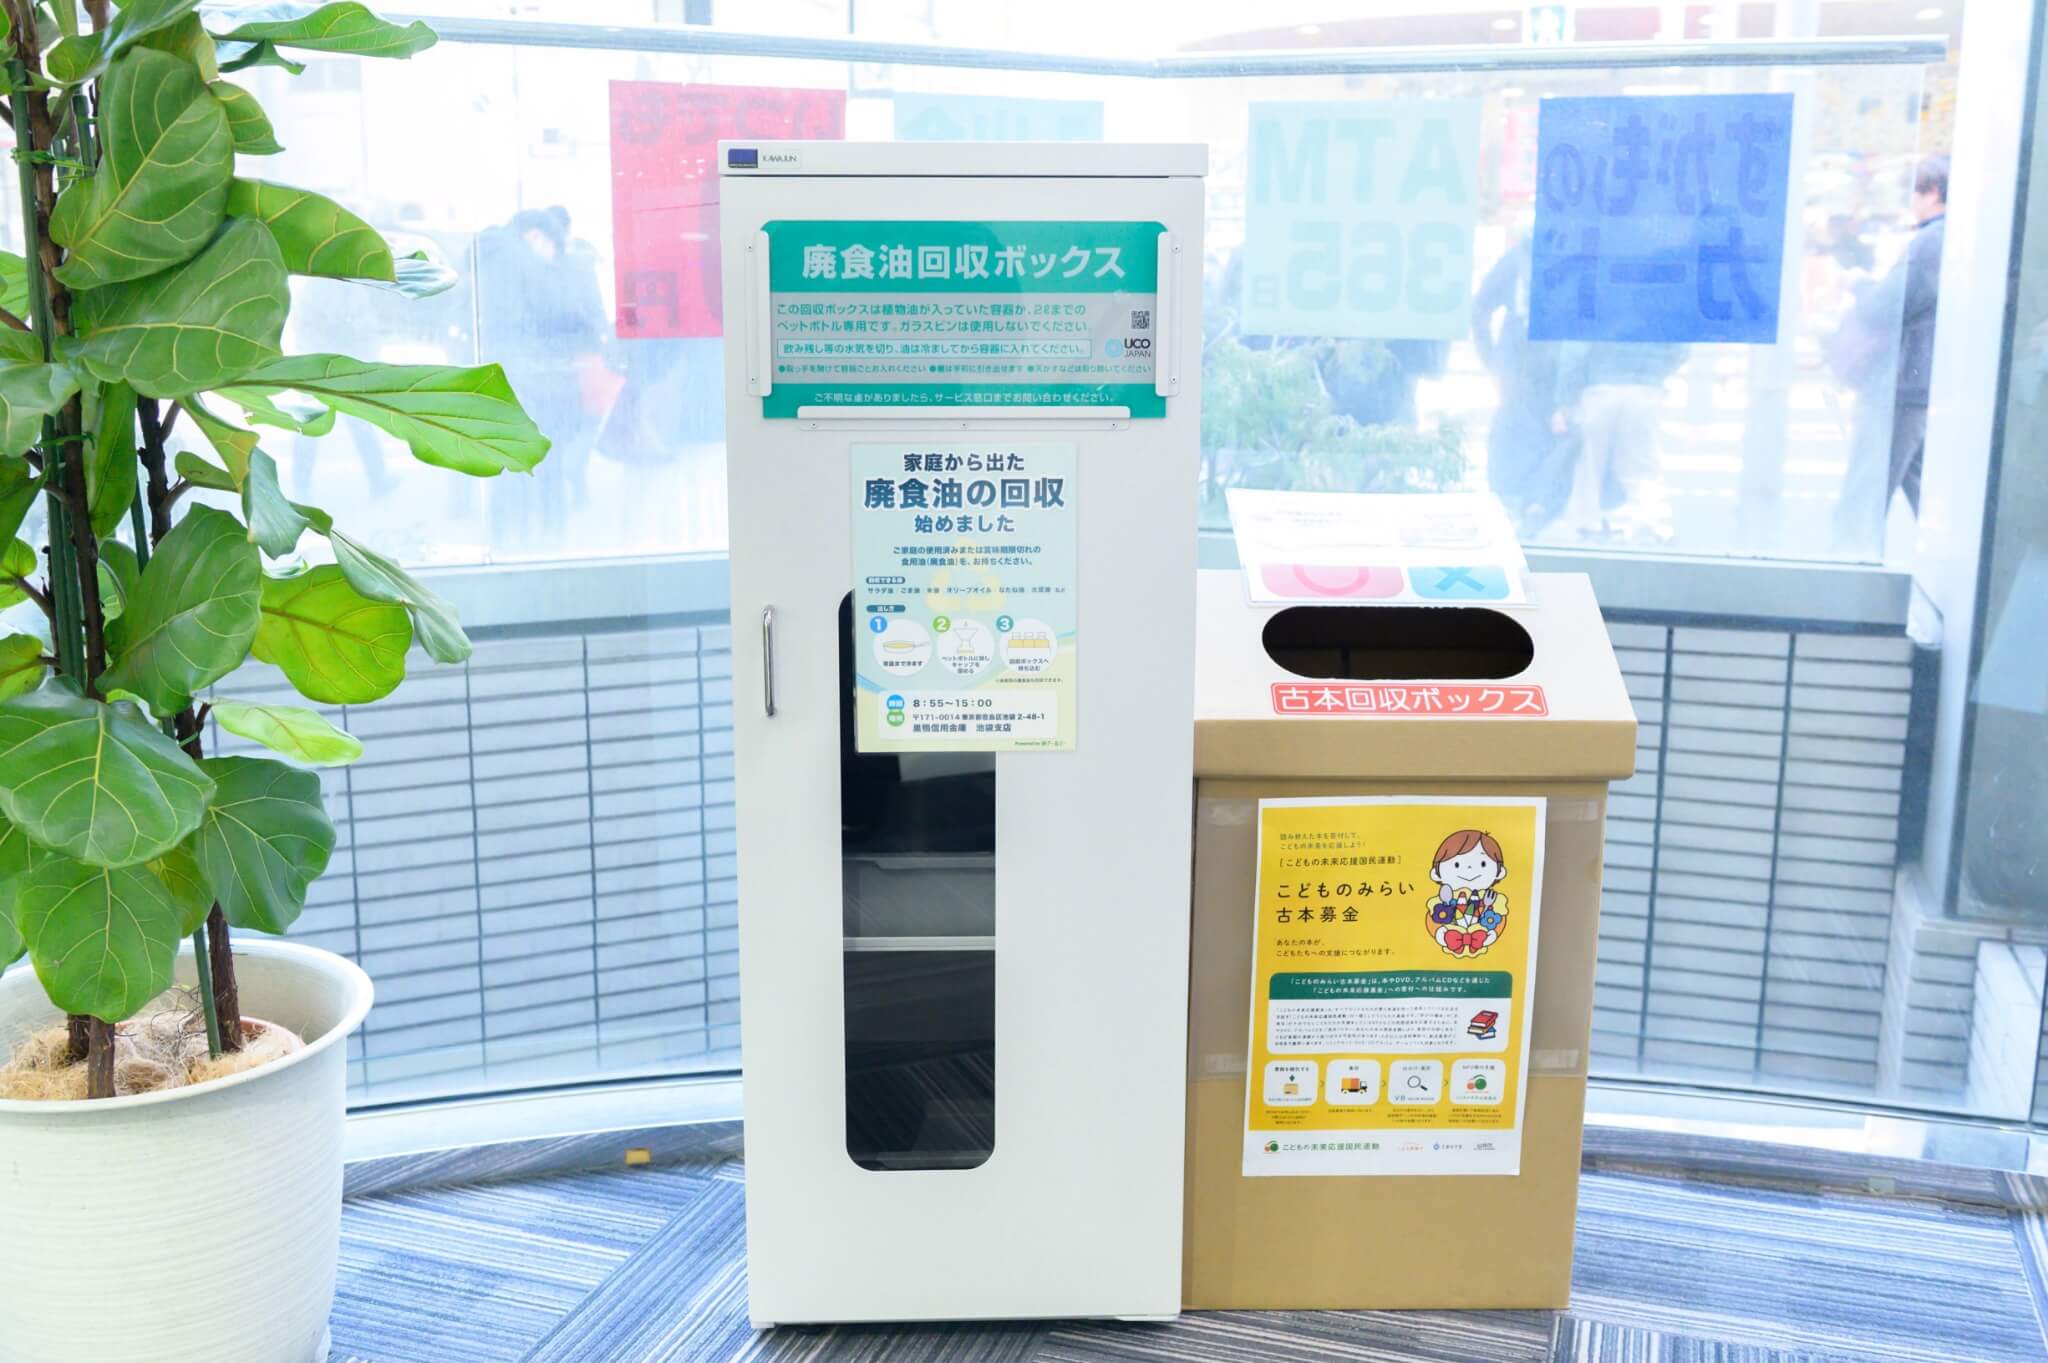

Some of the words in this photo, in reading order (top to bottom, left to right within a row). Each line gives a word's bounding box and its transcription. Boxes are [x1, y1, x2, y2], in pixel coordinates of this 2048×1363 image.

[801, 243, 1127, 281] 廃食油回収ボックス
[1124, 338, 1151, 350] UCO
[1124, 350, 1152, 359] JAPAN
[903, 453, 1025, 472] 家庭から出た
[863, 477, 1065, 509] 廃食油の回収
[914, 514, 1015, 533] 始めました
[874, 619, 883, 630] 1
[938, 619, 948, 631] 2
[999, 619, 1011, 631] 3
[1279, 687, 1542, 712] 古本回収ボックス
[975, 723, 1012, 733] 池袋支店
[1276, 880, 1415, 899] こどものみらい
[1275, 905, 1361, 924] 古本募金
